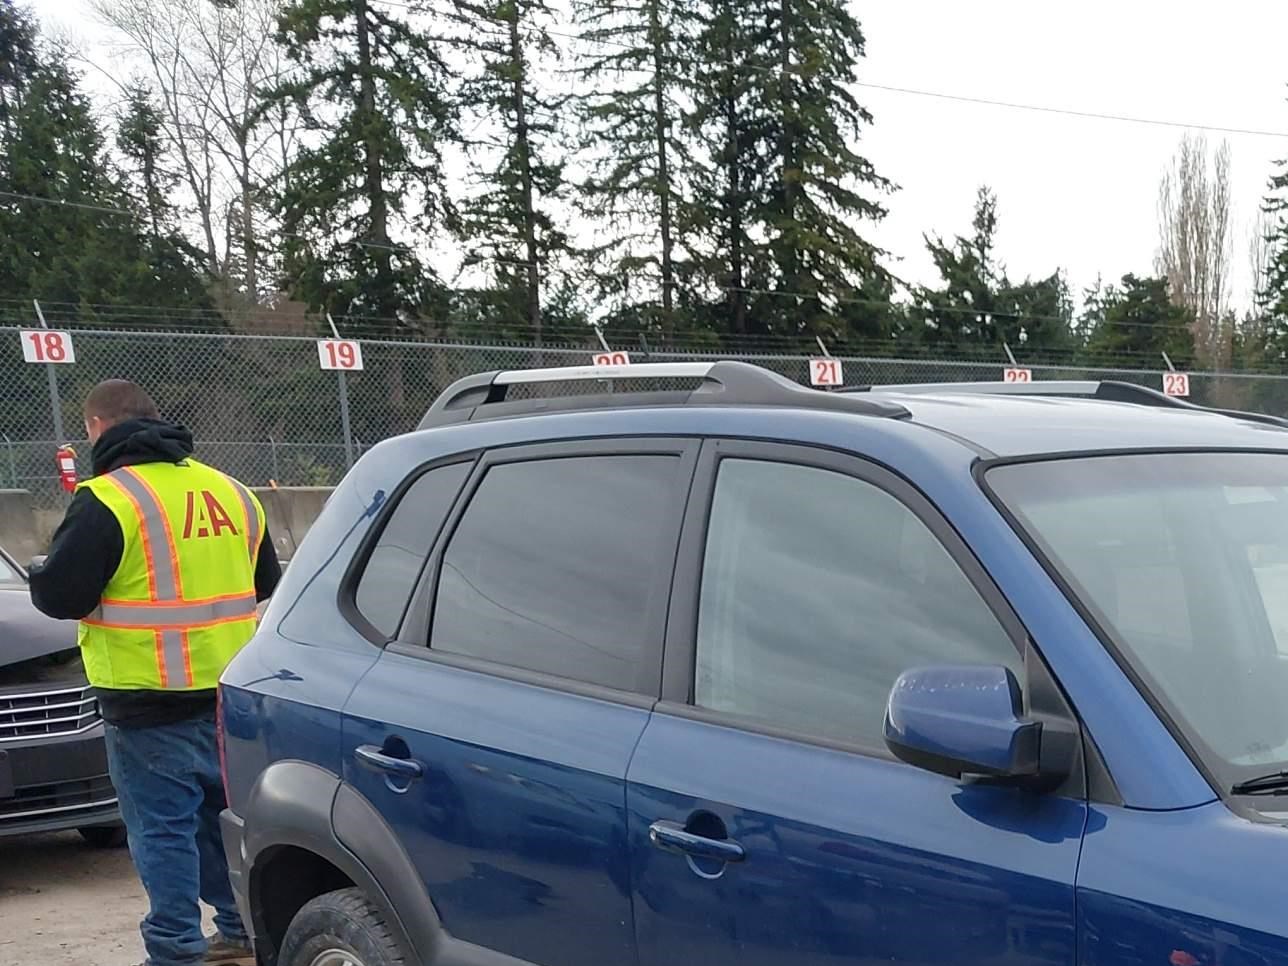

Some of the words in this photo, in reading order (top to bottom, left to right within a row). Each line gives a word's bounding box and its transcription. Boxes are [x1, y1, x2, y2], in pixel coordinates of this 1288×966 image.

[29, 333, 65, 361] 18
[326, 342, 355, 368] 19
[816, 362, 837, 384] 21
[1166, 375, 1186, 395] 23
